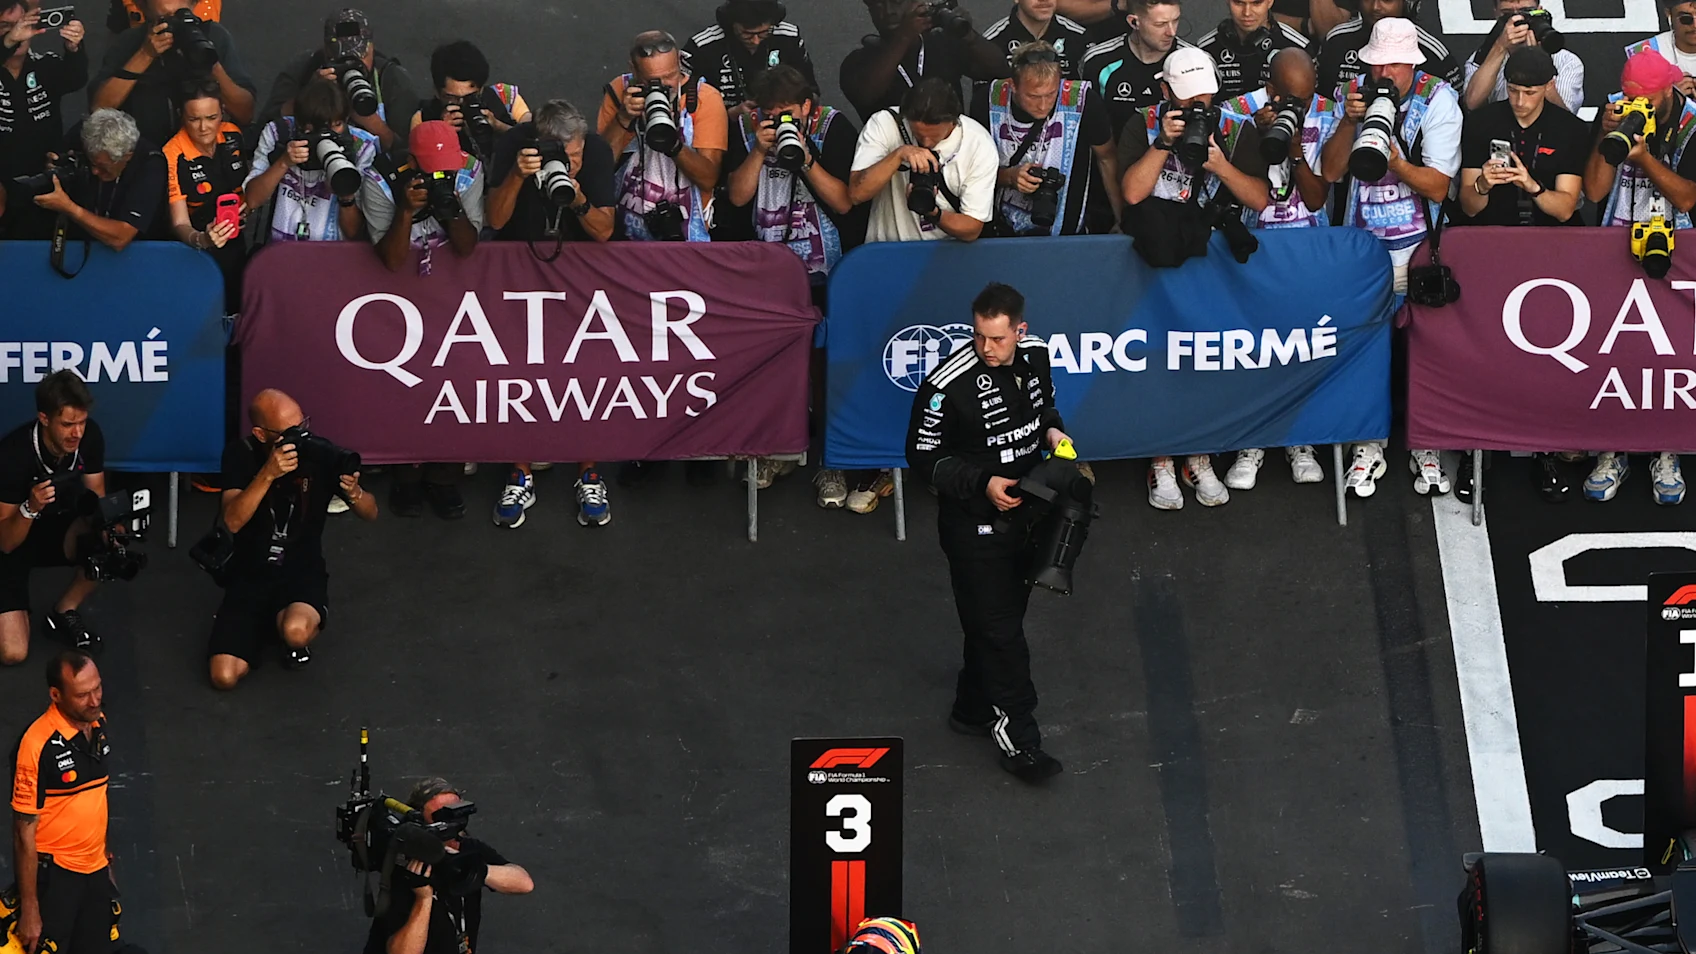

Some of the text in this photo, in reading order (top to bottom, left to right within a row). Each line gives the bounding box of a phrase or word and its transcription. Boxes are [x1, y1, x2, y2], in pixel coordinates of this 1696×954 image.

[0, 327, 169, 382] FERMÉ
[335, 290, 716, 388] QATAR
[1050, 315, 1338, 374] ARC FERMÉ
[424, 371, 717, 424] AIRWAYS
[988, 395, 1002, 406] UBS
[986, 414, 1041, 446] PETRONA
[826, 794, 872, 853] 3
